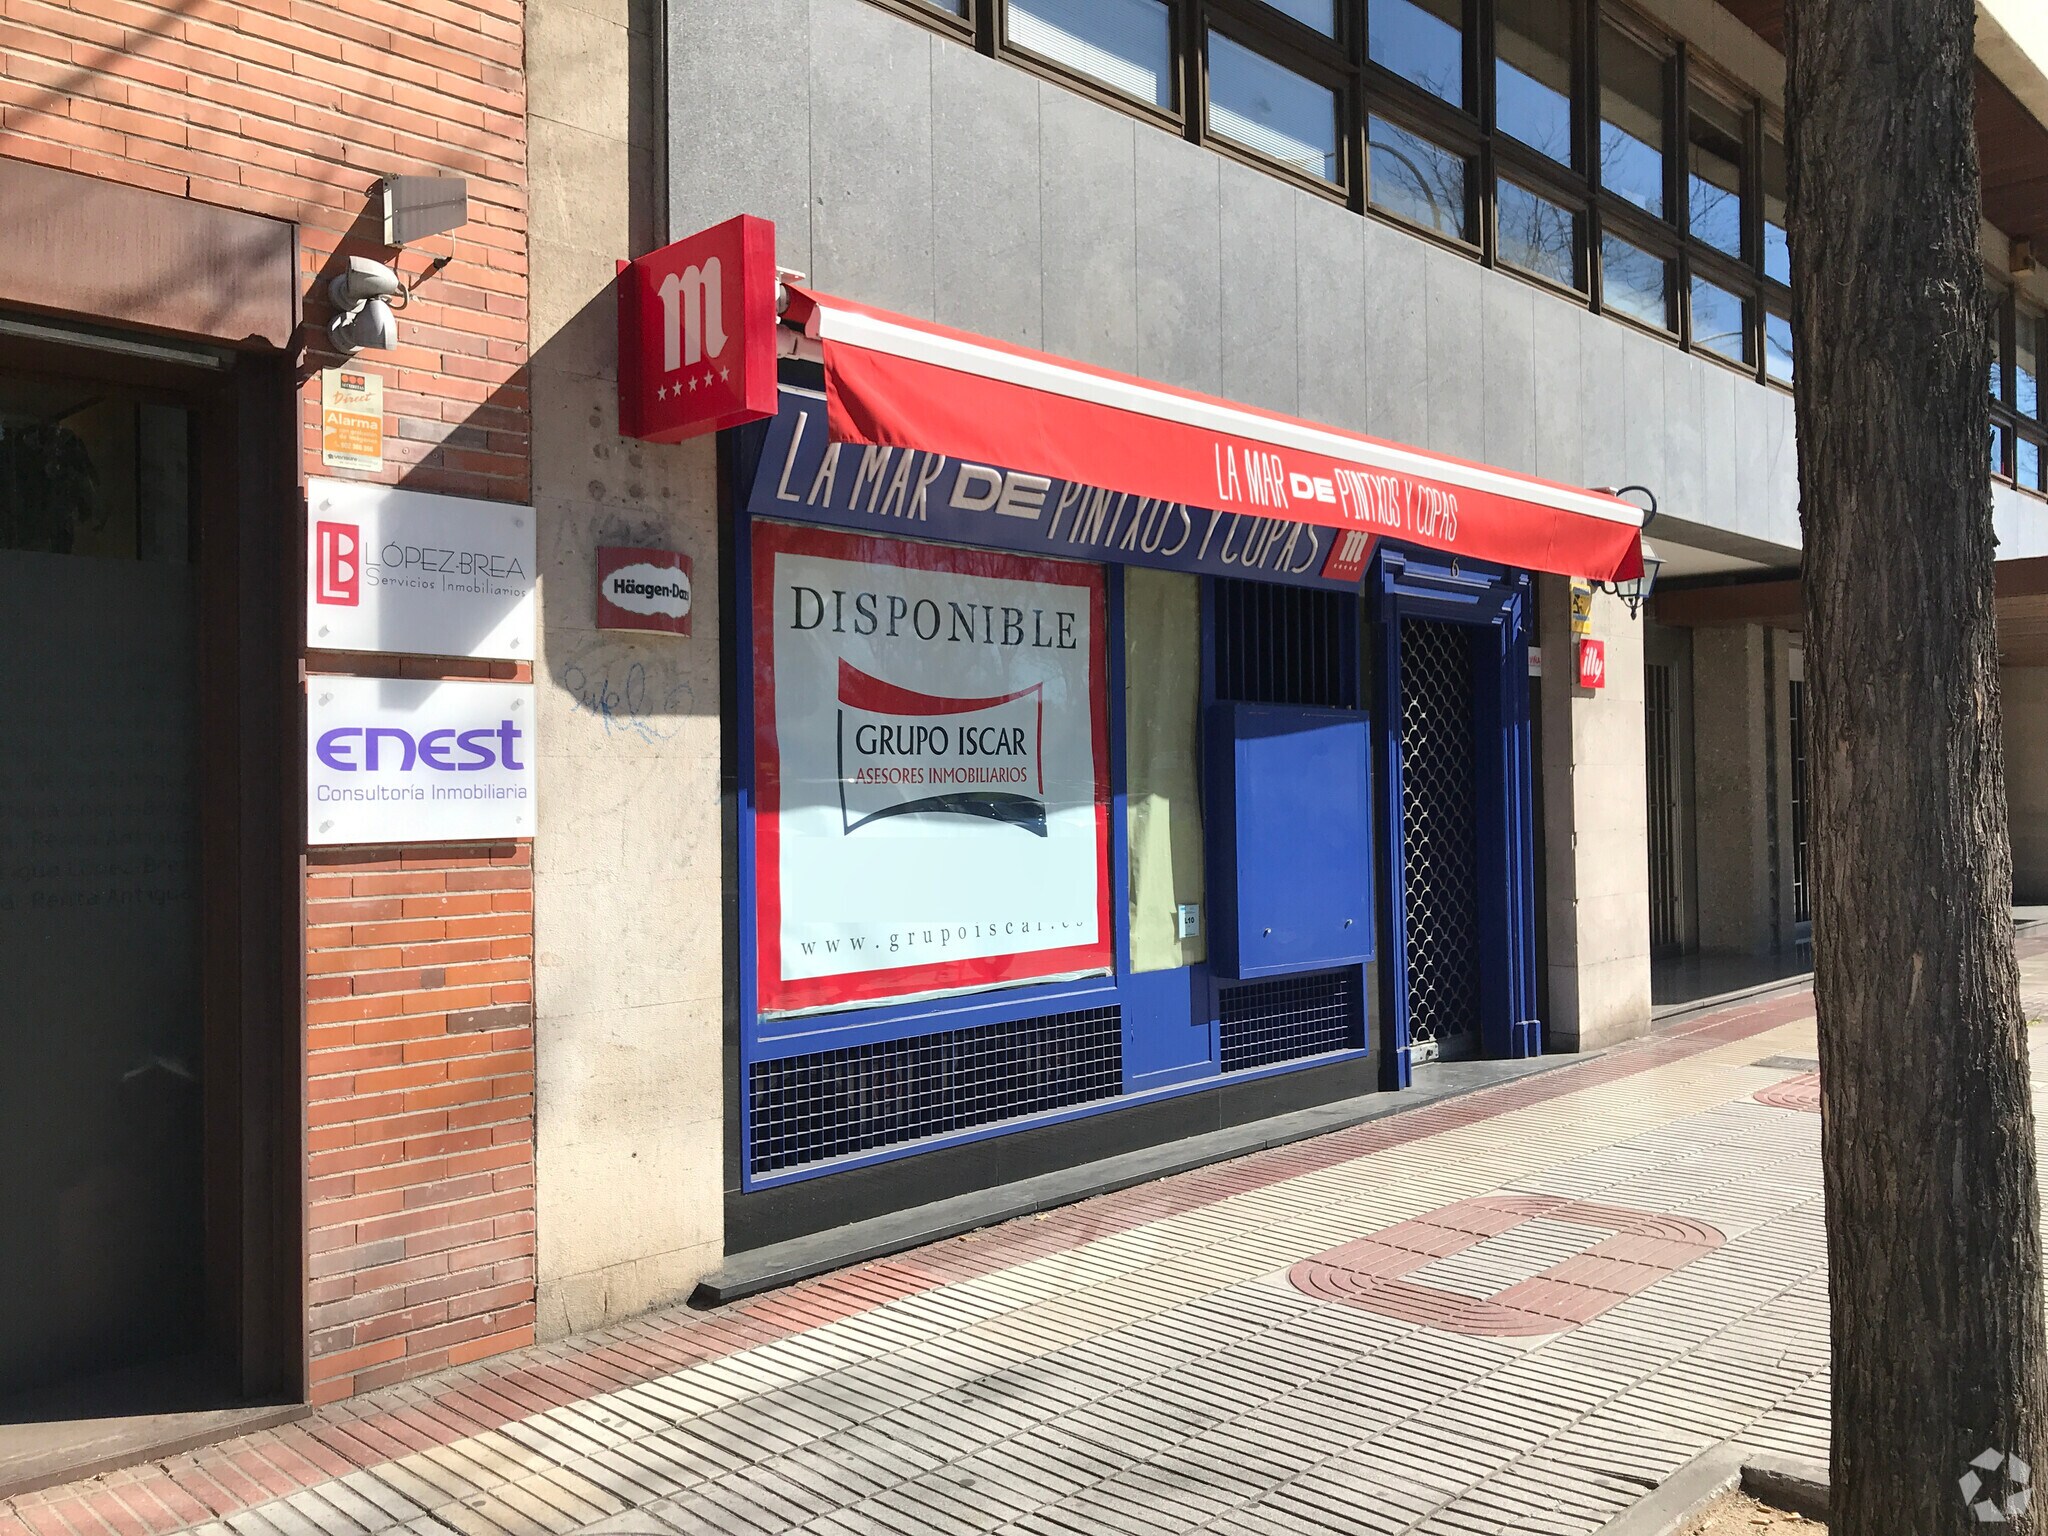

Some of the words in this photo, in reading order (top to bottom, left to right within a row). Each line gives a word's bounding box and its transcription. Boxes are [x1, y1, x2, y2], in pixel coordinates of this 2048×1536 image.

[333, 390, 374, 405] Direct
[327, 412, 378, 429] Alarma
[776, 410, 842, 509] LA
[848, 445, 947, 522] MAR
[949, 463, 1051, 520] DE
[1214, 442, 1242, 502] LA
[1244, 448, 1289, 510] MAR
[1289, 472, 1337, 504] DE
[1333, 467, 1401, 529] PINTXOS
[1403, 479, 1413, 531] Y
[1415, 484, 1459, 543] COPAS
[365, 541, 527, 581] LÓPEZ-BREA
[1450, 557, 1460, 579] 6
[366, 566, 436, 591] Servicios
[442, 573, 527, 598] Inmobiliarios
[790, 585, 1078, 650] DISPONIBLE
[1582, 646, 1604, 684] illy
[316, 720, 526, 772] enest
[855, 724, 949, 756] GRUPO
[958, 725, 1028, 756] ISCAR
[855, 767, 924, 785] ASESORES
[928, 766, 1028, 785] INMOBILIARIOS
[317, 783, 425, 802] Consultoría
[432, 783, 528, 801] Inmobiliaria
[801, 922, 1084, 956] www.grupoiscar.
